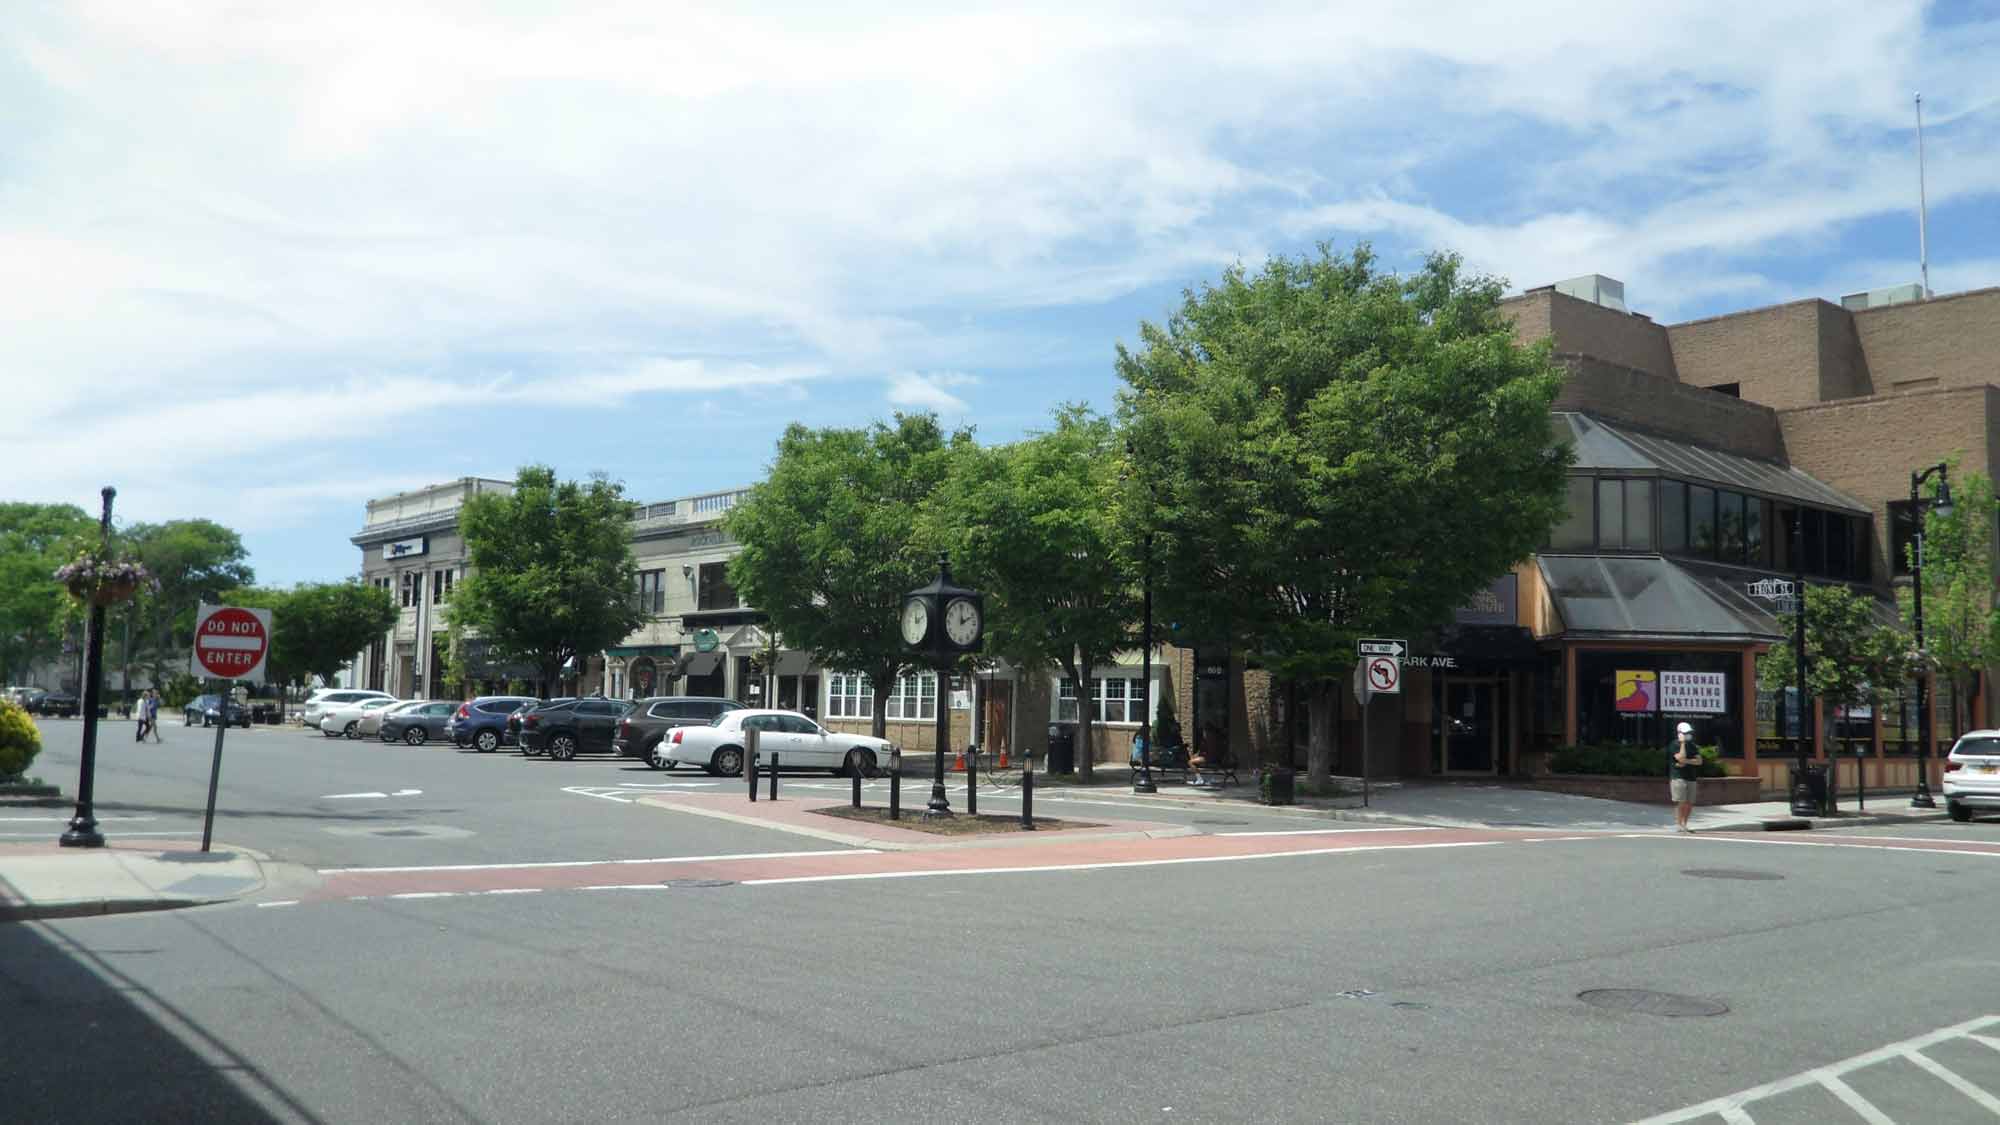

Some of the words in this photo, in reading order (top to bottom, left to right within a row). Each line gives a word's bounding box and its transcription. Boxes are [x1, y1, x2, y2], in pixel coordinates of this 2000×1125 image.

[207, 620, 225, 632] DO
[231, 621, 257, 633] NOT
[1362, 644, 1374, 652] ONE
[1378, 644, 1391, 652] WAY
[207, 652, 252, 664] ENTER
[1431, 657, 1458, 668] AVE.
[1664, 675, 1720, 685] PERSONAL
[1664, 686, 1720, 697] TRAINING
[1664, 698, 1720, 708] INSTITUTE
